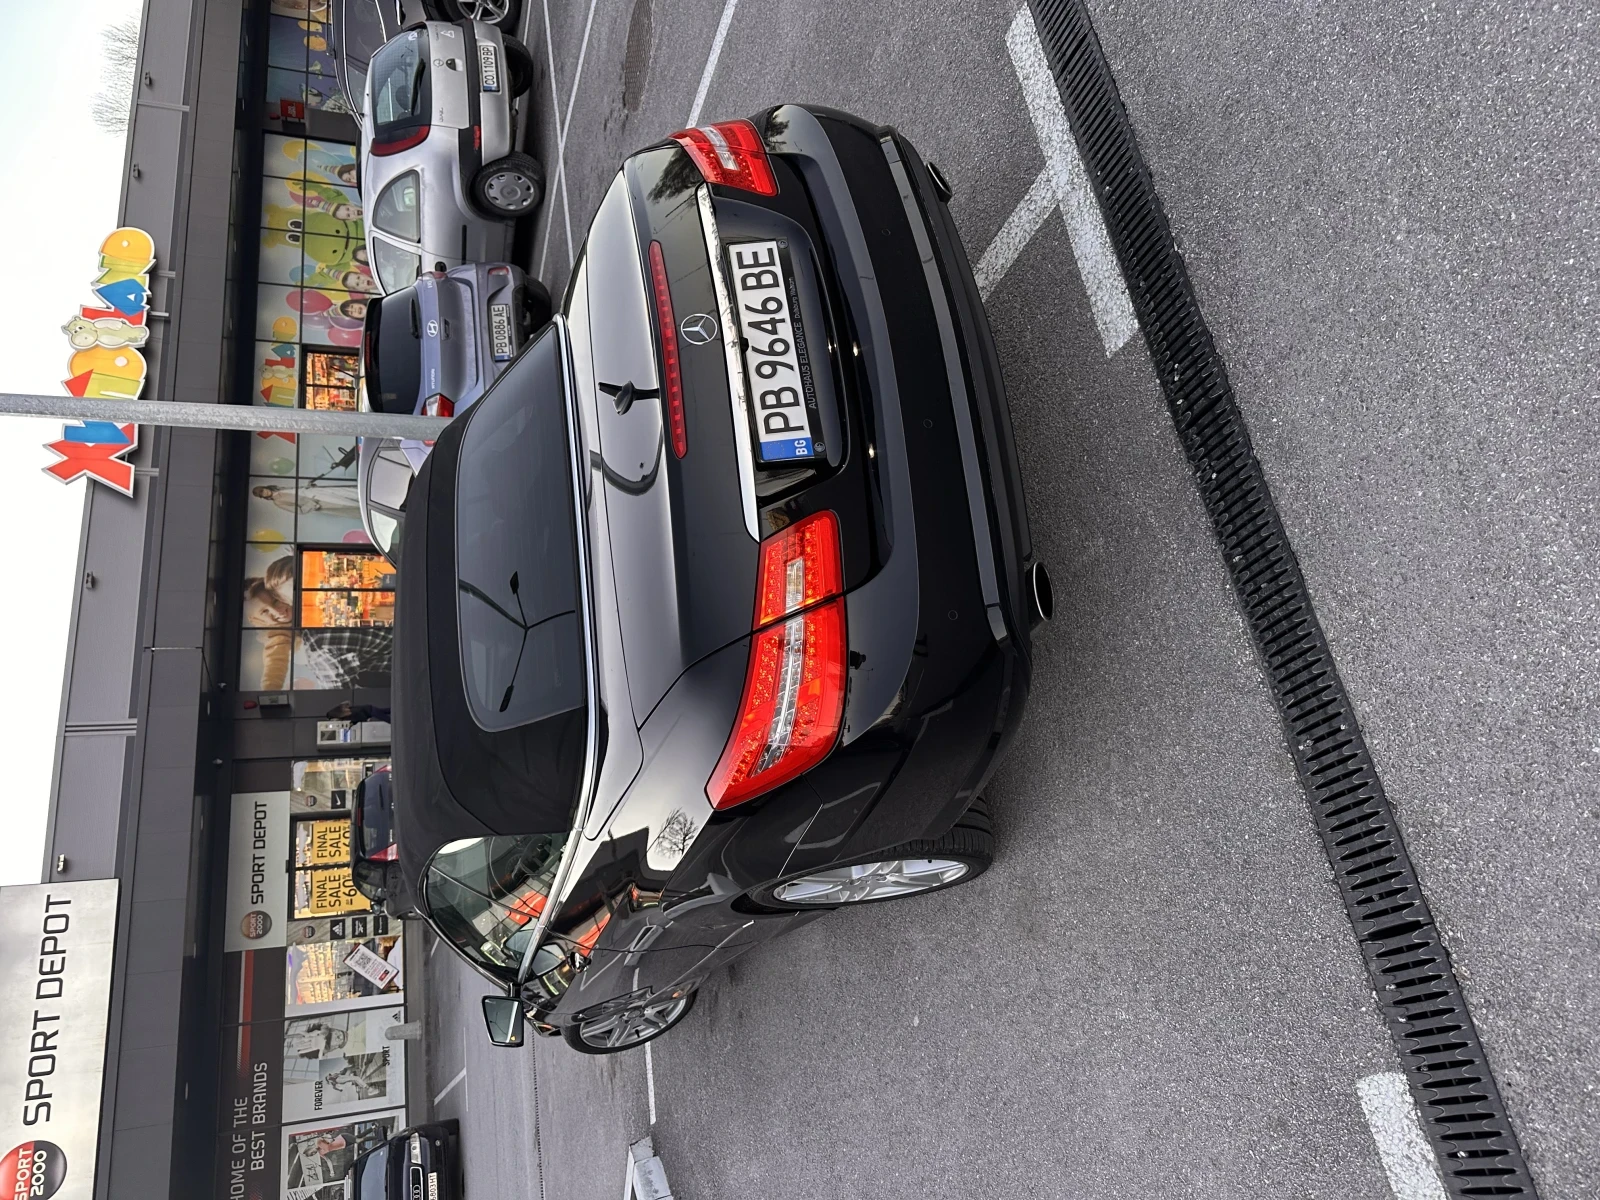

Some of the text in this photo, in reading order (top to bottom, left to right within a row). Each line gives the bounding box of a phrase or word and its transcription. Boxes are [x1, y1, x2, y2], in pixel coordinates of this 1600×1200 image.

[736, 248, 804, 434] PB 9646 BE
[793, 321, 809, 364] ELEGANCE
[802, 365, 817, 409] AUTOHAUS
[794, 439, 808, 456] BG
[251, 801, 267, 905] SPORT DEPOT
[316, 827, 327, 858] FINAL
[329, 826, 341, 858] SALE
[316, 876, 327, 909] FINAL
[328, 874, 341, 908] SALE
[22, 894, 71, 1126] SPORT DEPOT
[382, 1046, 390, 1066] SPORT
[233, 1097, 248, 1128] THE
[314, 1080, 323, 1111] FOREVER
[250, 1062, 268, 1171] BEST BRANDS
[232, 1133, 247, 1154] OF
[14, 1148, 32, 1200] SPORT
[30, 1150, 47, 1197] 2000
